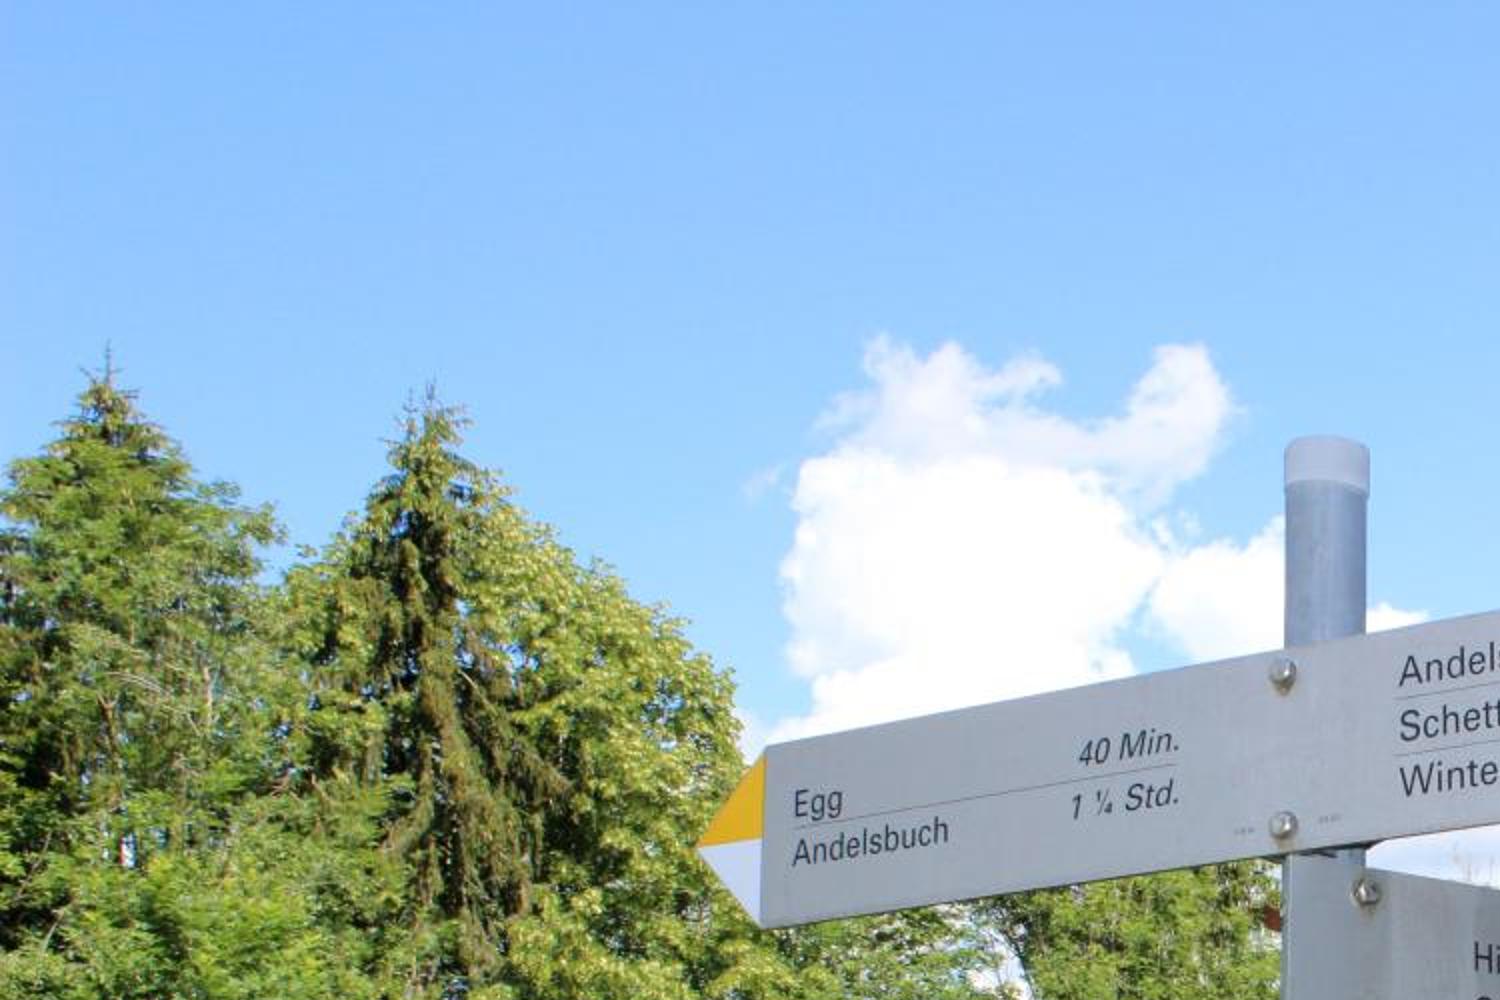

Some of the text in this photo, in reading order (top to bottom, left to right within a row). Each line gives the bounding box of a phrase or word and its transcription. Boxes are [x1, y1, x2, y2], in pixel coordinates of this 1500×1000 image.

[794, 727, 1180, 822] Egg 40 Min.
[791, 815, 949, 867] Andelsbuch
[1072, 793, 1083, 820] 1
[1124, 777, 1179, 812] Std.
